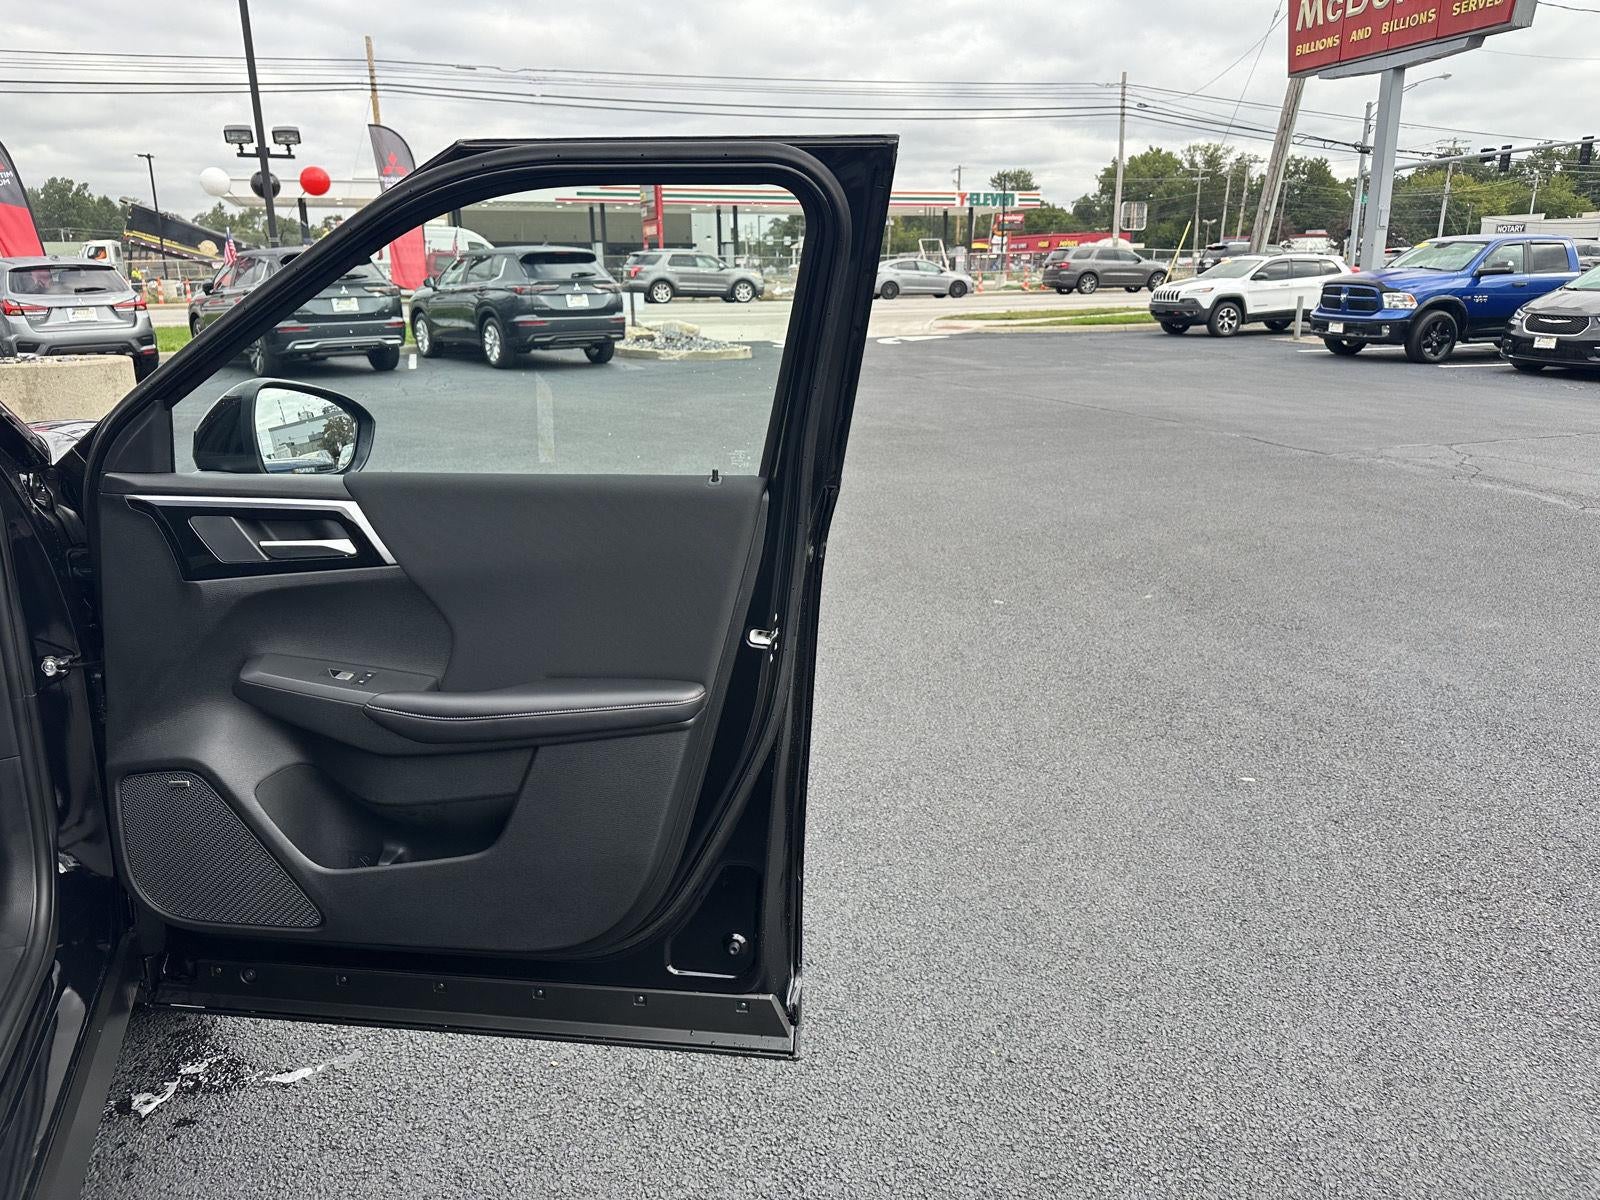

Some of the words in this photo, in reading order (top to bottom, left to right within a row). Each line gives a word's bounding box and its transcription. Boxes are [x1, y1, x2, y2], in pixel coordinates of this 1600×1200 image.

[1295, 35, 1340, 56] BILLIONS
[1350, 26, 1372, 43] AND
[1381, 9, 1437, 35] BILLIONS
